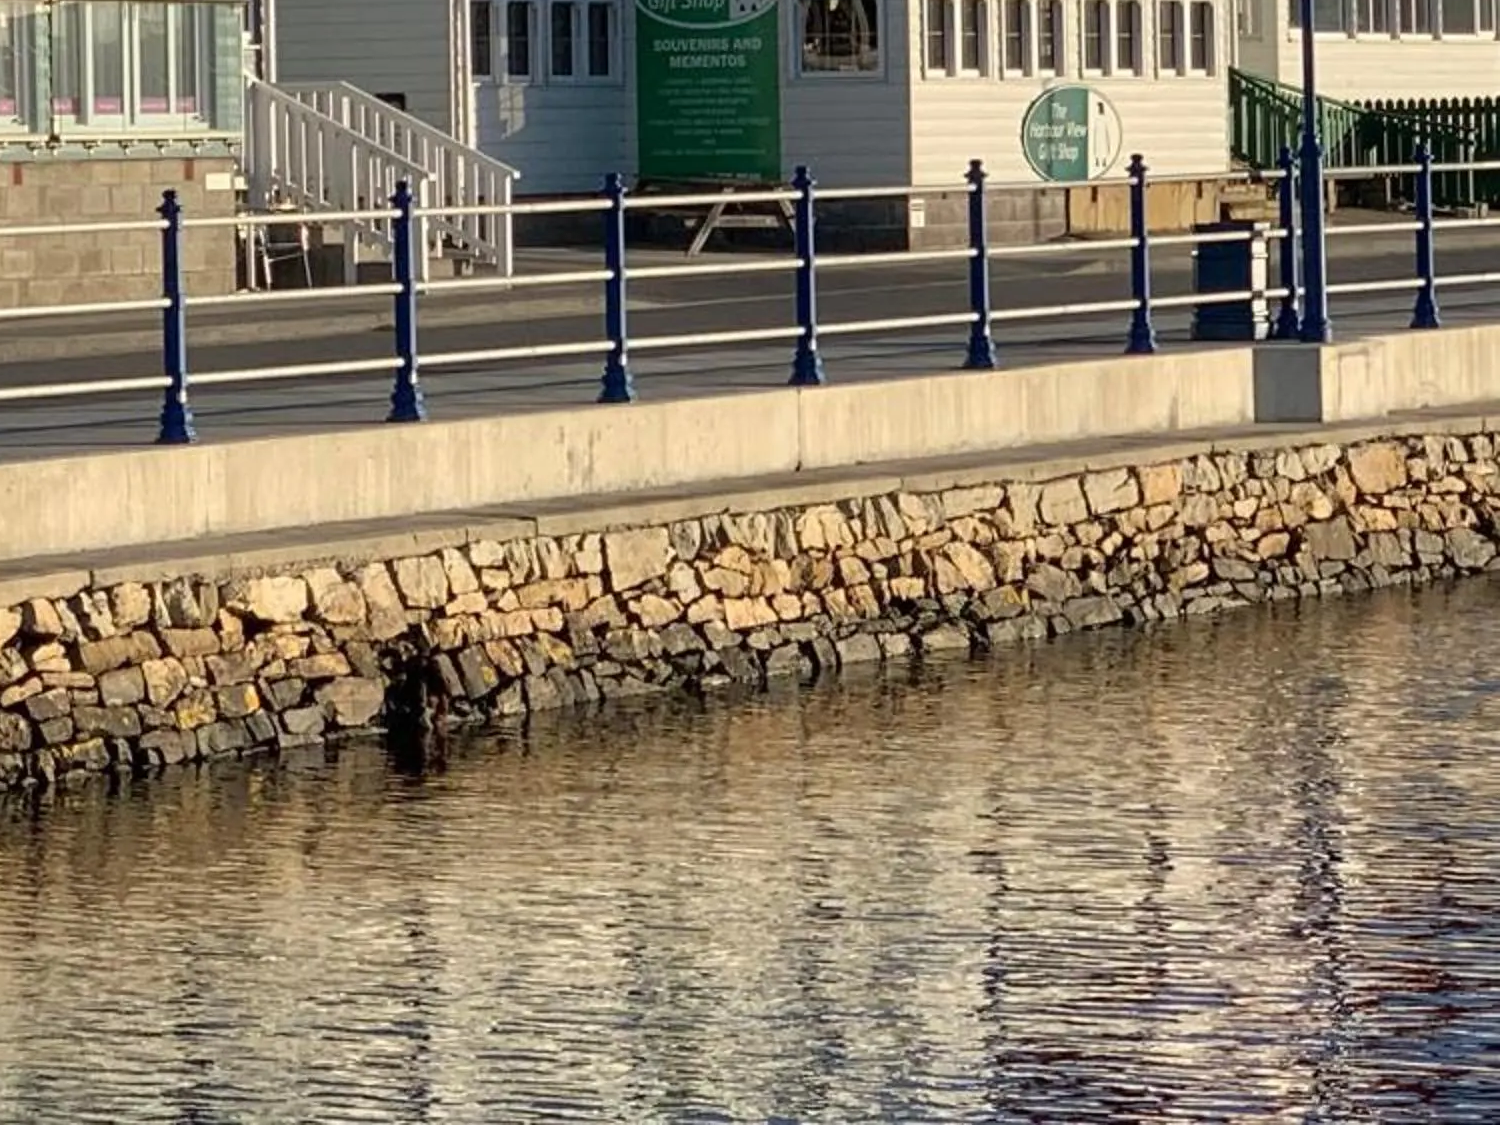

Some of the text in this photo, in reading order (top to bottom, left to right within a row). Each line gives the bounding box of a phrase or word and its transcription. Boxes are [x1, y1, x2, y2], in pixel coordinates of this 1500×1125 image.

[653, 37, 763, 52] SOUVENIRS AND
[669, 54, 746, 68] MEMENTOS
[1051, 102, 1068, 119] The
[1067, 121, 1087, 138] View
